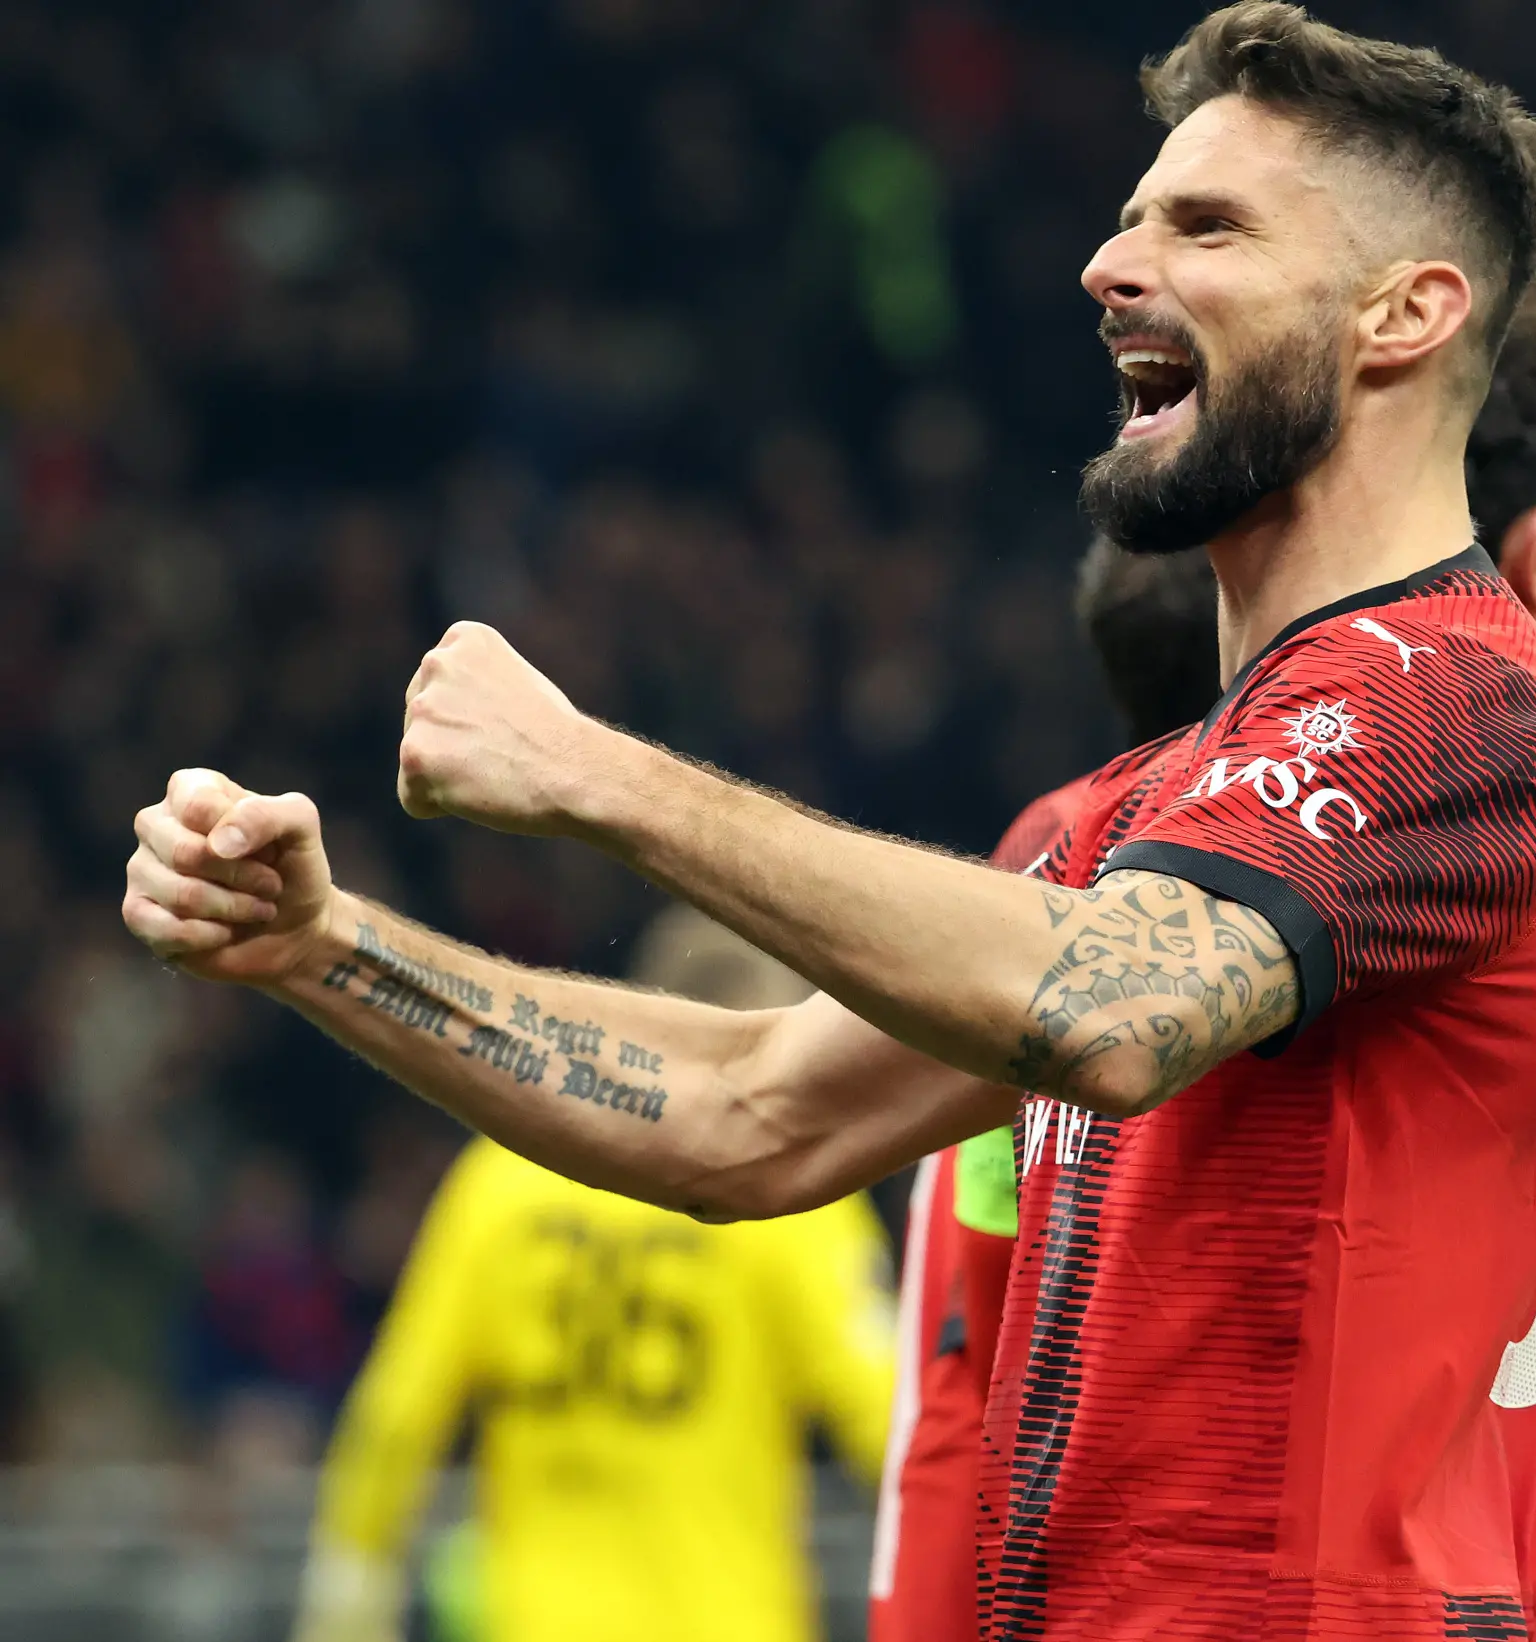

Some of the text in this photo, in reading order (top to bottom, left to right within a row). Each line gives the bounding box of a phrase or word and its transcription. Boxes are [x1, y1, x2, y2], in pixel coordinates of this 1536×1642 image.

[1182, 756, 1367, 840] MSC
[508, 993, 607, 1057] Regit
[618, 1040, 663, 1075] me
[557, 1057, 669, 1124] Deerit
